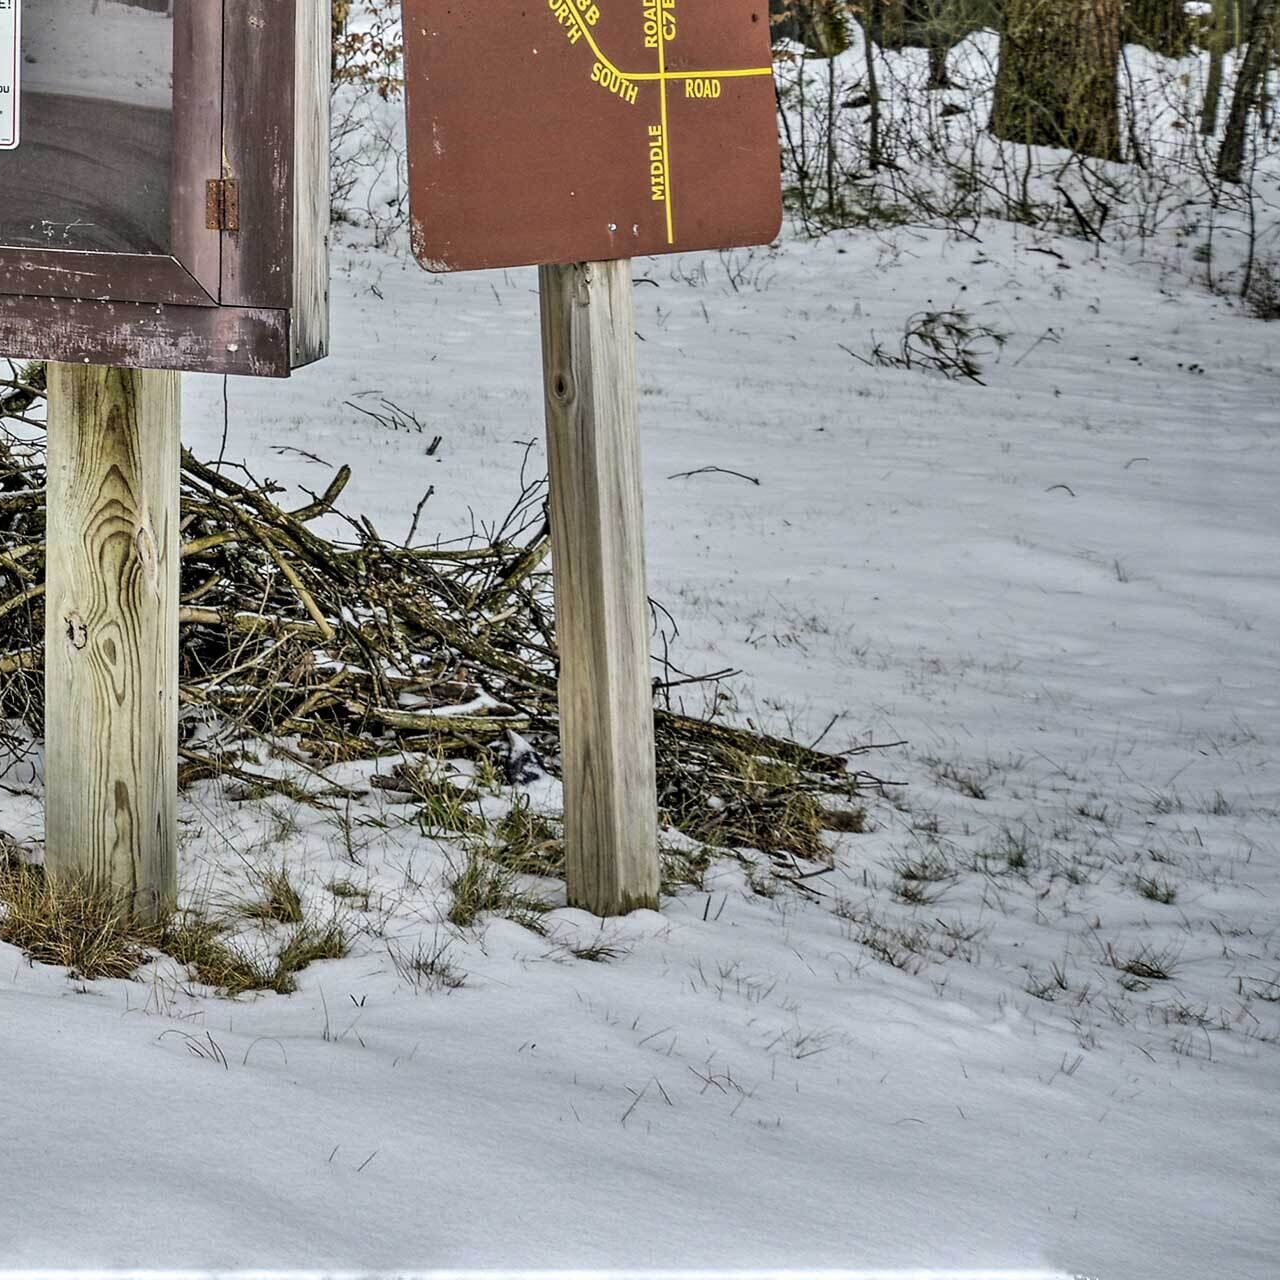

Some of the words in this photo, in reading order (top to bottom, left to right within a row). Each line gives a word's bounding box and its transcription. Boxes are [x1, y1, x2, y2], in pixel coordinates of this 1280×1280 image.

[590, 62, 639, 105] SOUTH
[684, 78, 721, 99] ROAD
[648, 124, 665, 201] MIDDLE
